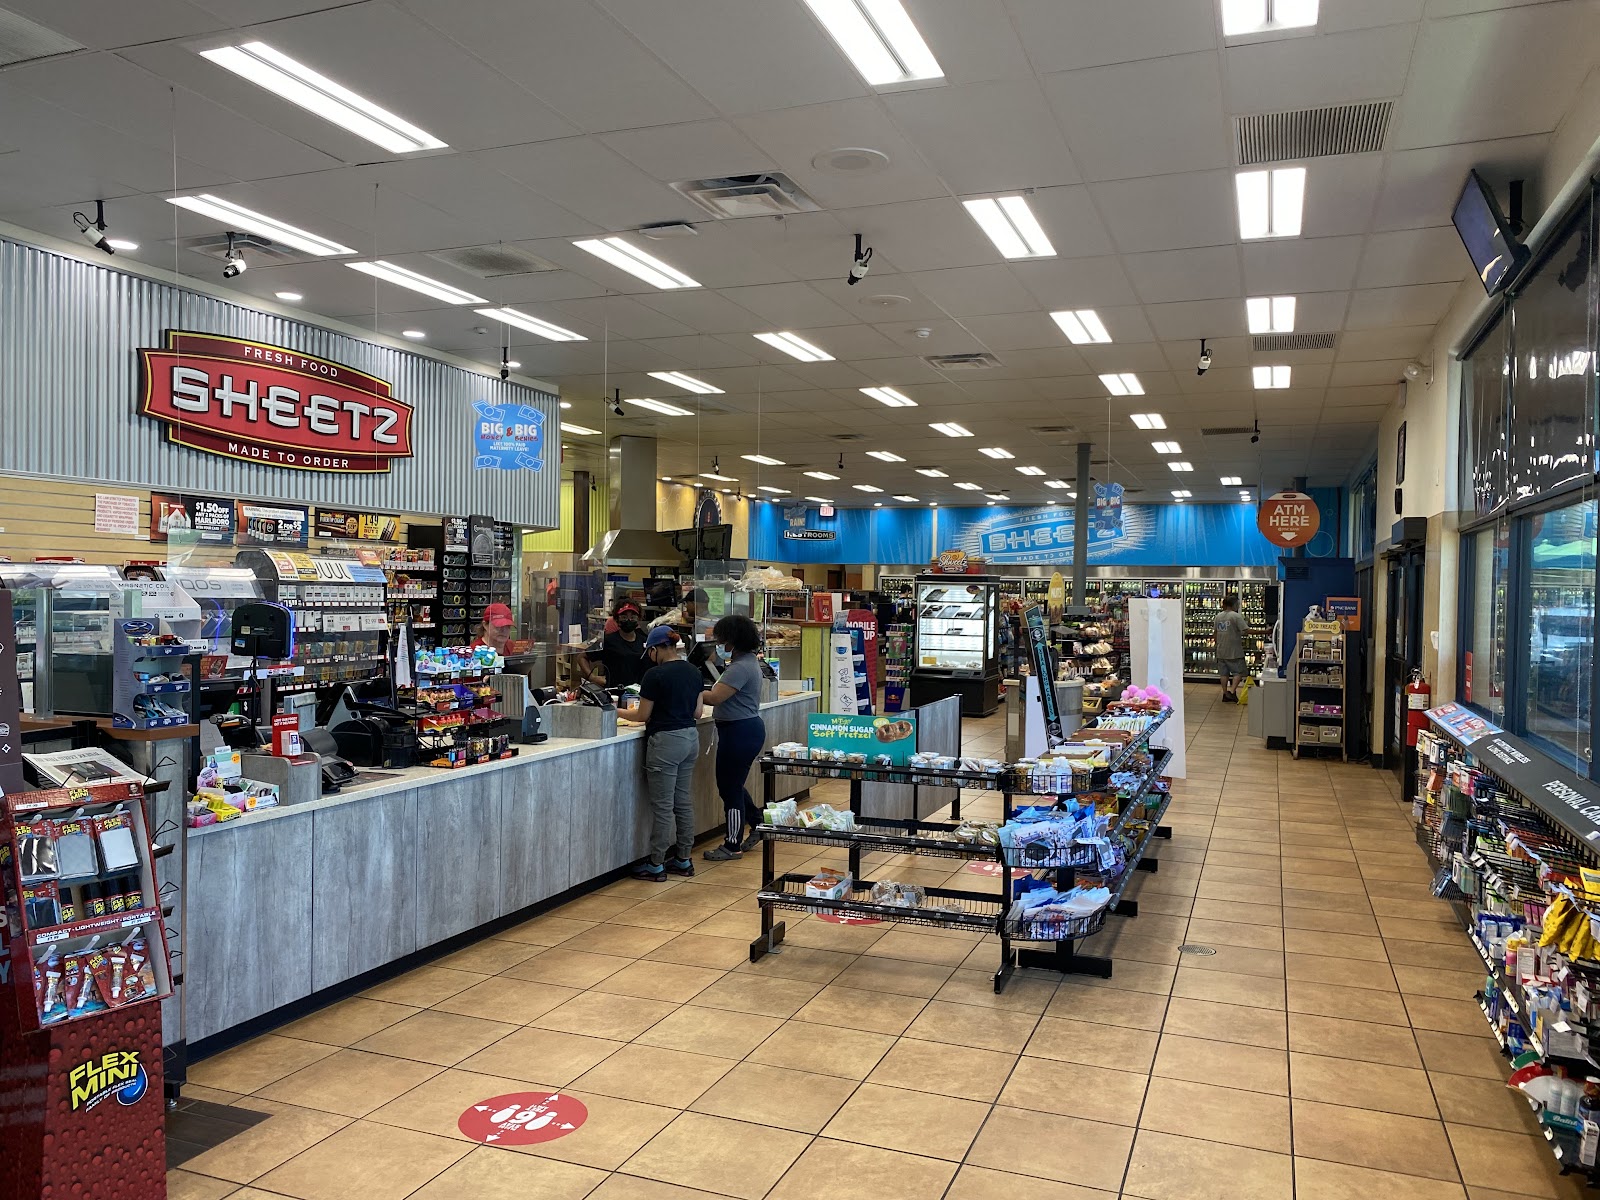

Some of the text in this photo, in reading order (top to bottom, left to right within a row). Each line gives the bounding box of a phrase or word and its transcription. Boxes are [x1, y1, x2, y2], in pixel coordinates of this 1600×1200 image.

[244, 346, 339, 377] FRESH FOOD
[172, 366, 398, 444] SHEETZ
[482, 423, 503, 436] BIG
[515, 424, 537, 436] BIG
[228, 443, 349, 468] MADE TO ORDER
[195, 502, 218, 513] $1.50
[1097, 496, 1120, 507] BIG BIG
[1273, 505, 1305, 515] ATM
[195, 517, 230, 525] MARLBORO
[278, 520, 284, 529] 2
[1020, 514, 1048, 523] FRESH
[1269, 516, 1310, 527] HERE
[810, 724, 875, 733] CINNAMON SUGAR
[813, 730, 872, 739] Soft Pretzel
[69, 789, 89, 797] FLEX
[1542, 780, 1591, 809] PERSONAL
[36, 910, 156, 938] COMPACT LIGHTWEIGHT PORTABLE
[69, 1052, 139, 1090] FLEX
[71, 1063, 138, 1111] MINI
[86, 1087, 112, 1106] PORTABLE
[112, 1081, 125, 1090] FLEX
[85, 1097, 102, 1113] FAMILY
[103, 1092, 111, 1100] OF
[508, 1111, 537, 1124] 6
